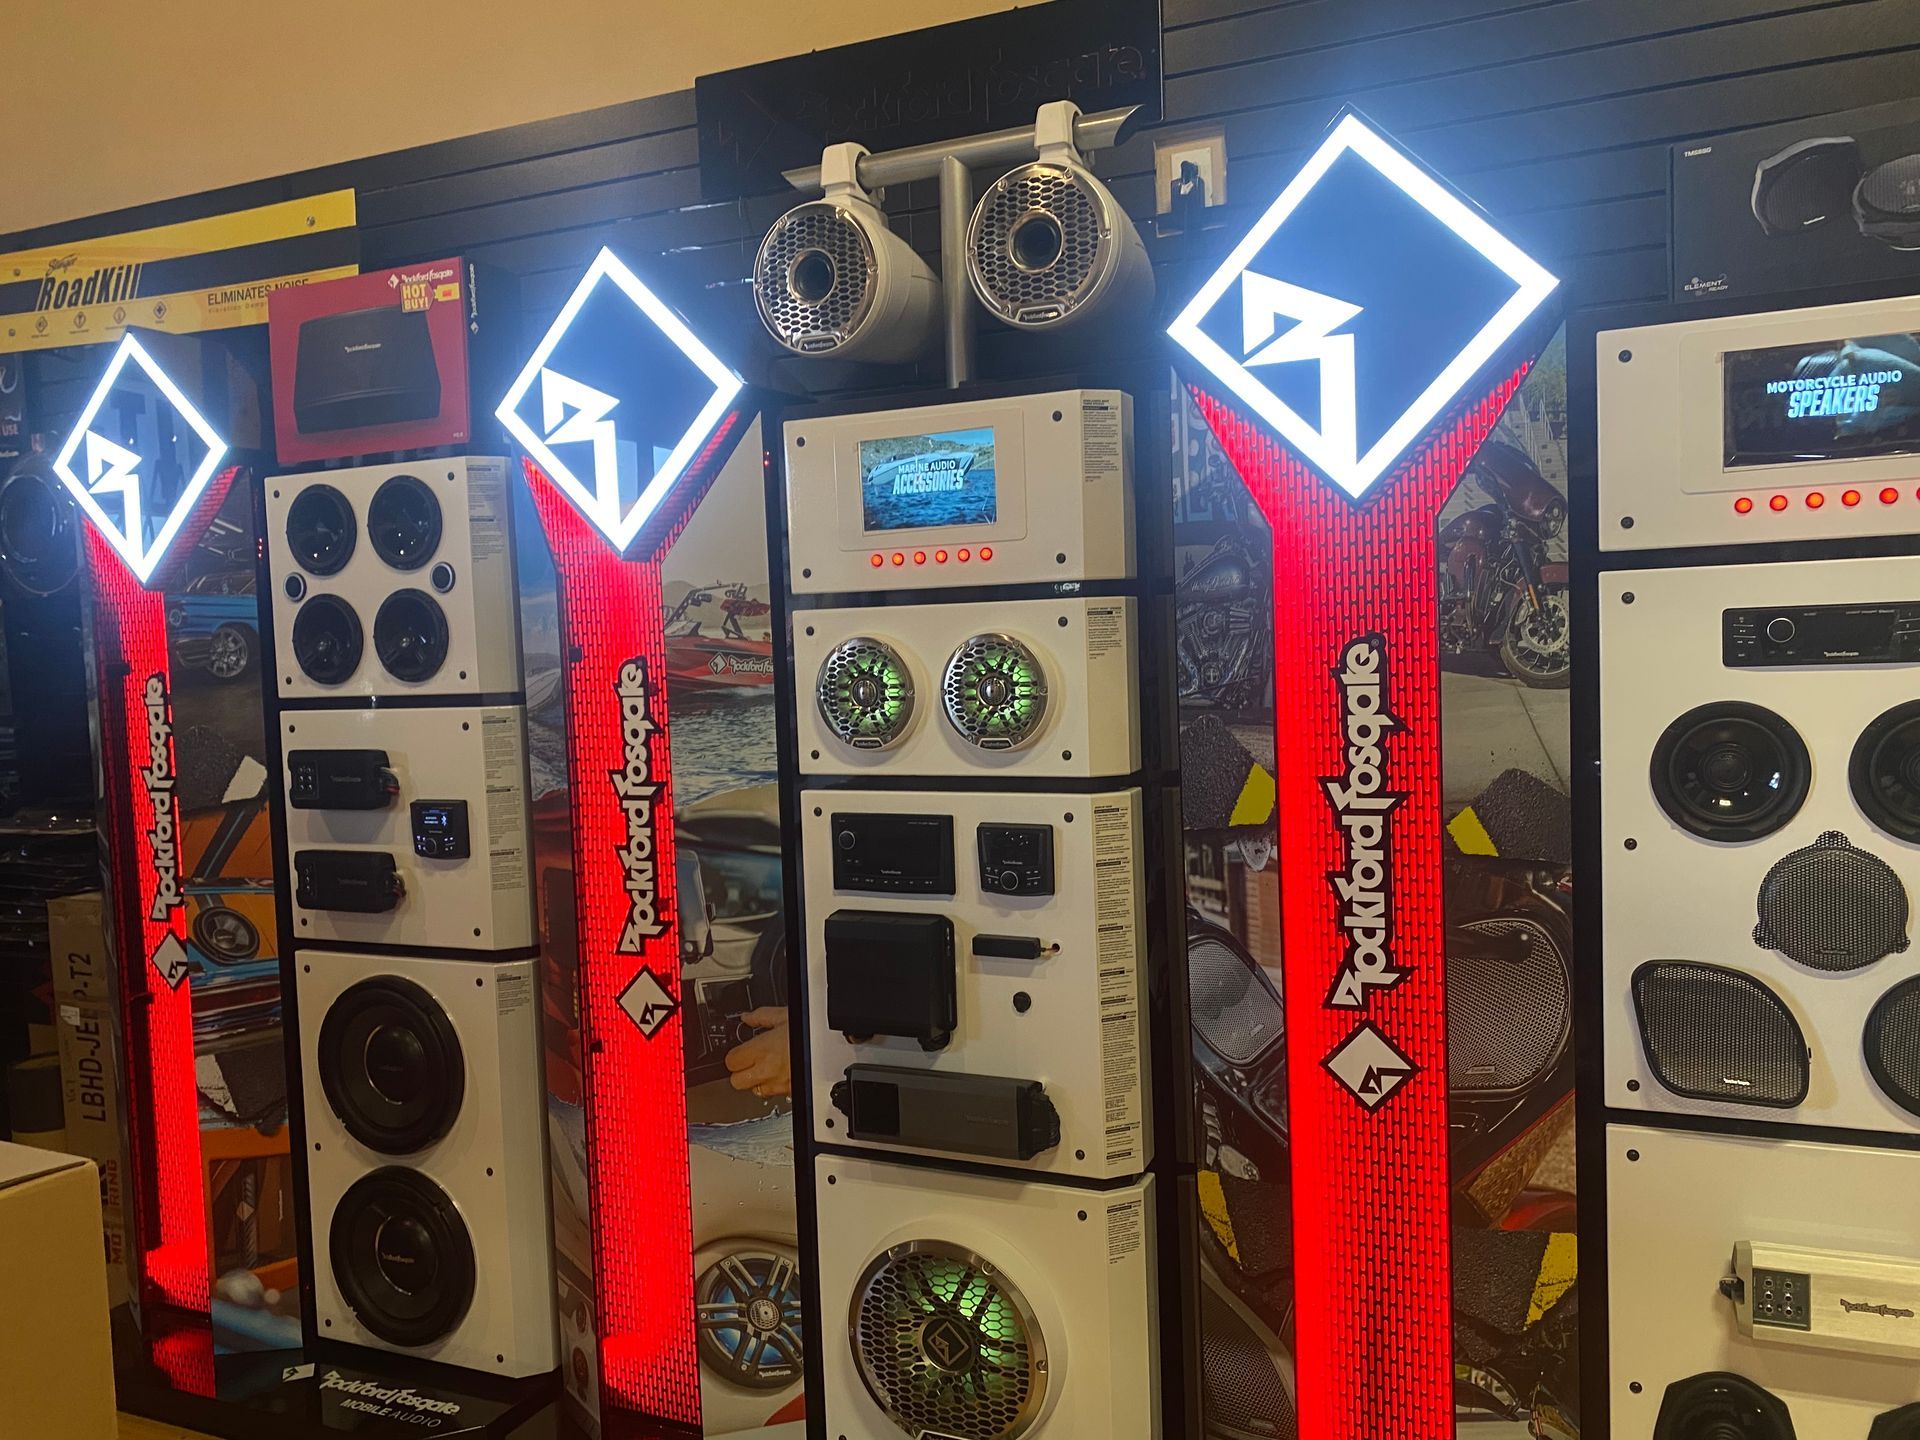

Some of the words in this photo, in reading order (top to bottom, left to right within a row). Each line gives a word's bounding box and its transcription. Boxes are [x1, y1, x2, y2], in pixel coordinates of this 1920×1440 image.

[37, 264, 141, 312] RoadKill
[207, 284, 272, 306] ELIMINATES
[403, 284, 427, 299] HOT
[1684, 280, 1722, 291] ELEMENT
[404, 296, 429, 310] BUY!
[1766, 374, 1857, 394] MOTORCYCLE
[1859, 370, 1903, 386] AUDIO
[1787, 384, 1881, 418] SPEAKERS
[898, 461, 930, 474] MARINE
[930, 460, 956, 472] AUDIO
[892, 469, 965, 495] ACCESSORIES
[318, 1369, 391, 1402] Rockford
[339, 1398, 393, 1418] MOBILE
[391, 1409, 442, 1429] AUDIO
